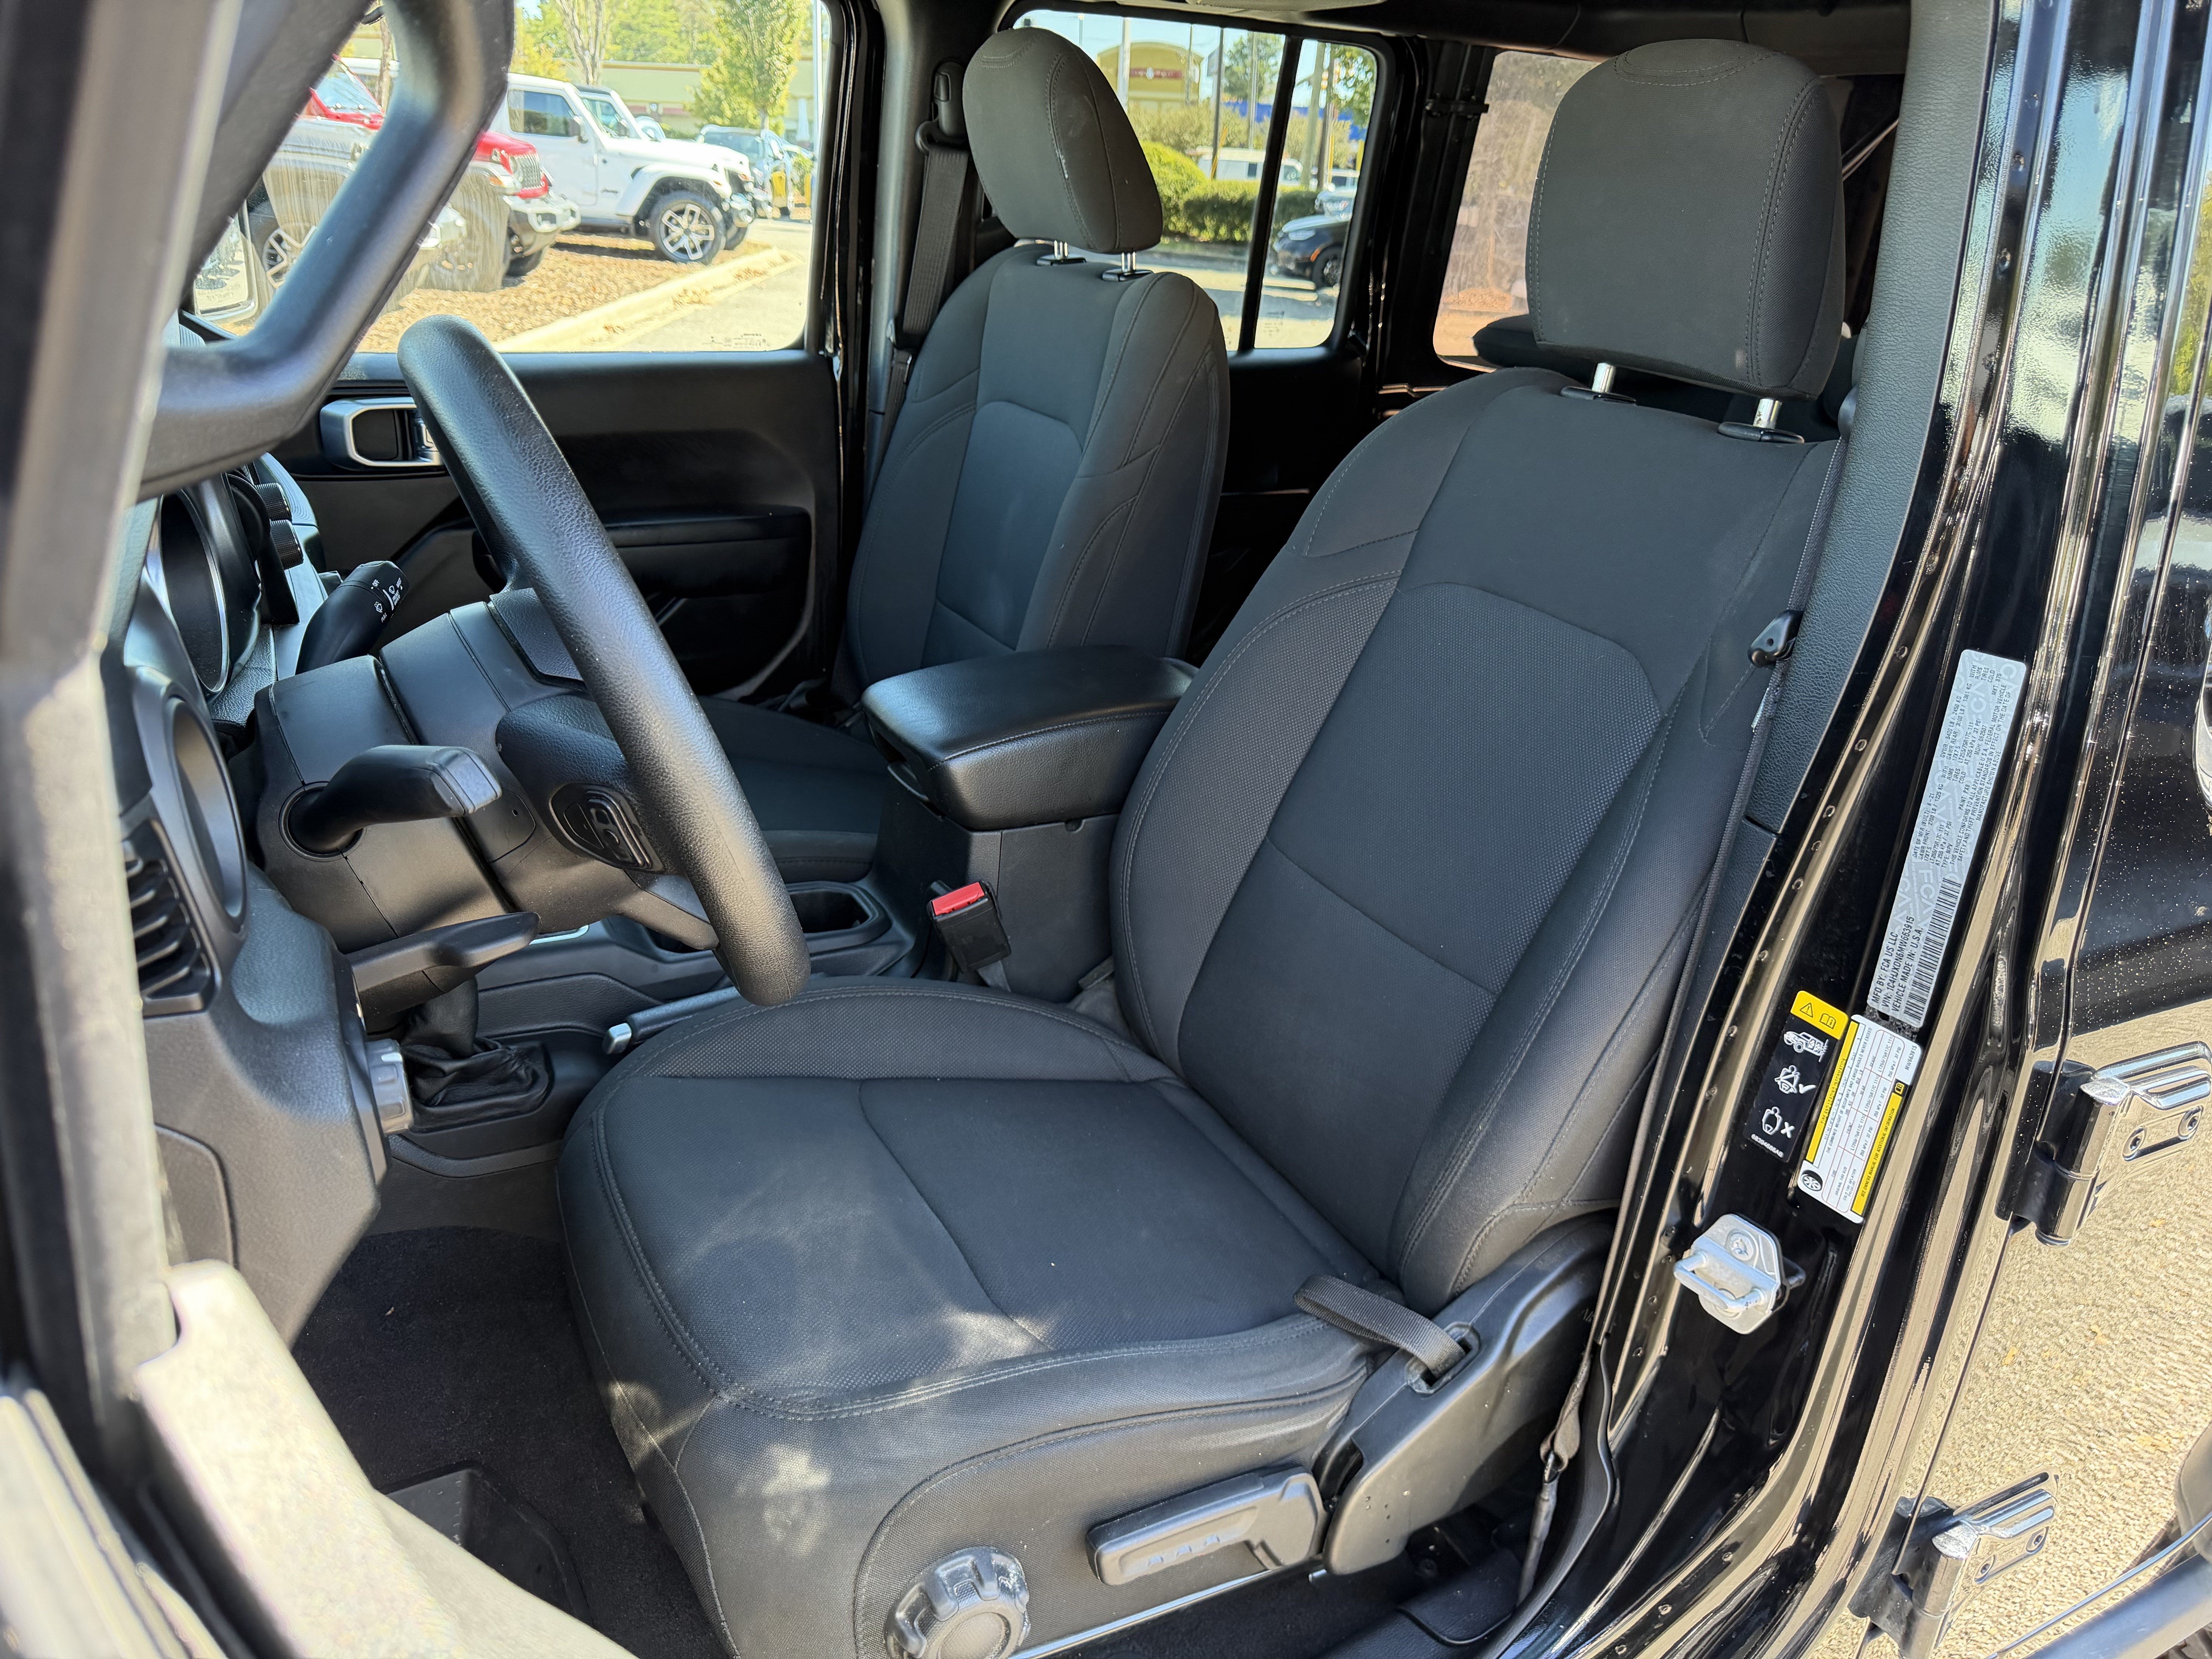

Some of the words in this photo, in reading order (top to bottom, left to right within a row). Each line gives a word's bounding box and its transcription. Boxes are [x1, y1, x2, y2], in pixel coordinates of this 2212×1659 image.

[1969, 665, 1977, 678] WITH
[1975, 666, 1983, 679] RIMS
[1980, 666, 1989, 681] TIRES
[1987, 669, 1995, 683] COLD
[1990, 683, 1999, 695] MKT:
[1951, 703, 1960, 715] 2450
[2001, 698, 2009, 712] DATE
[1977, 725, 1987, 742] 062507
[1989, 732, 1999, 750] EFFECT
[1946, 745, 1954, 760] GAWR
[1952, 768, 1961, 782] TIRES
[1953, 834, 1963, 854] VEHICLE
[1958, 808, 1971, 834] CONFORMS
[1971, 762, 1984, 791] APPLICABLE
[1984, 723, 1996, 745] FEDERAL
[1990, 705, 2001, 723] MOTOR
[1996, 684, 2007, 704] VEHICLE
[1979, 757, 1992, 786] STANDARDS
[1958, 771, 1966, 784] COLD
[1975, 785, 1991, 821] MANUFACTURE
[1986, 767, 1996, 785] SHOWN
[1992, 750, 2001, 766] ABOVE
[1958, 794, 1967, 810] PAINT:
[1970, 787, 1984, 816] PREVENTION
[1966, 817, 1975, 832] THEFT
[1917, 845, 1926, 860] GAWR
[1957, 843, 1967, 862] SAFETY
[1941, 854, 1950, 868] TYPE:
[1887, 931, 1898, 945] LLC
[1910, 925, 1923, 949] U.S.A.
[1884, 945, 1894, 957] US
[1906, 949, 1916, 961] IN:
[1880, 957, 1891, 972] FCA
[1900, 961, 1913, 982] MADE
[1876, 972, 1886, 986] BY:
[1871, 986, 1882, 1003] MFD
[1881, 992, 1892, 1008] VIN:
[1891, 982, 1906, 1013] VEHICLE
[1904, 1044, 1917, 1070] MW663915
[1841, 1088, 1851, 1109] OCCUPANTS
[1868, 1160, 1876, 1176] MANUAL
[1876, 1132, 1886, 1153] ADDITIONAL
[1883, 1107, 1895, 1132] INFORMATION
